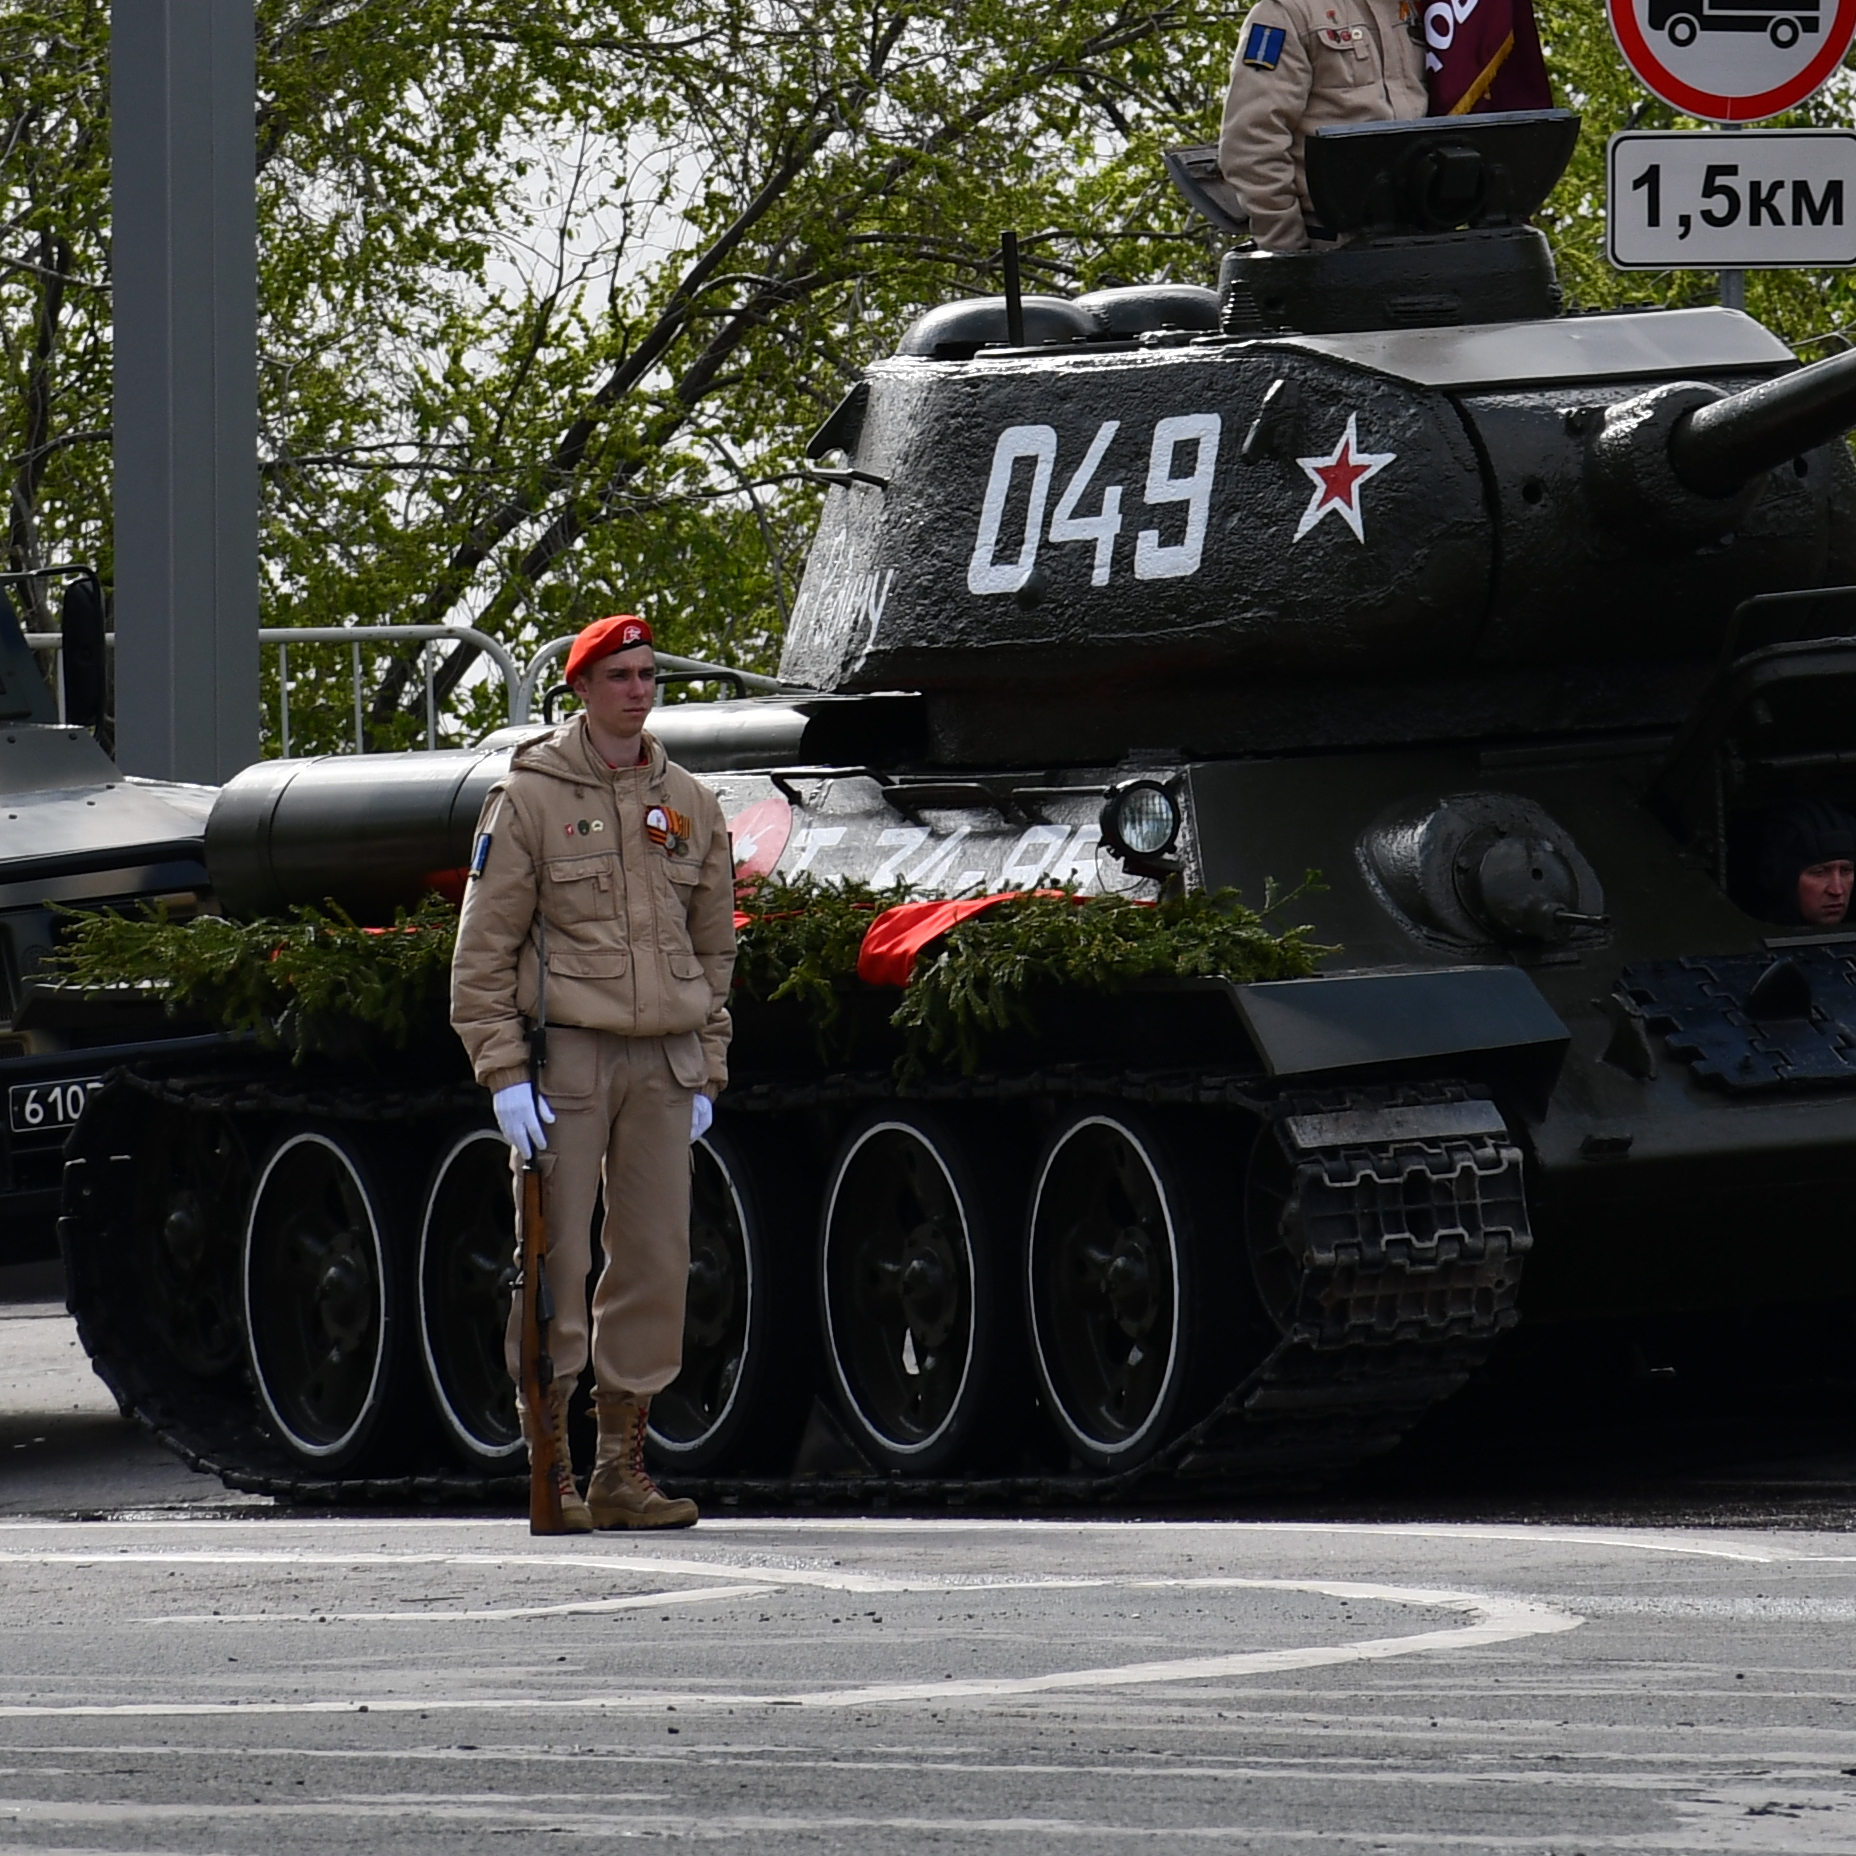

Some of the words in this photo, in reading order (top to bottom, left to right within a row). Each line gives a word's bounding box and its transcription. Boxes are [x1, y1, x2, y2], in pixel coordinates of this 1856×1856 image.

[1631, 163, 1844, 241] 1,5км
[967, 412, 1222, 595] 049
[24, 1080, 105, 1125] 610
